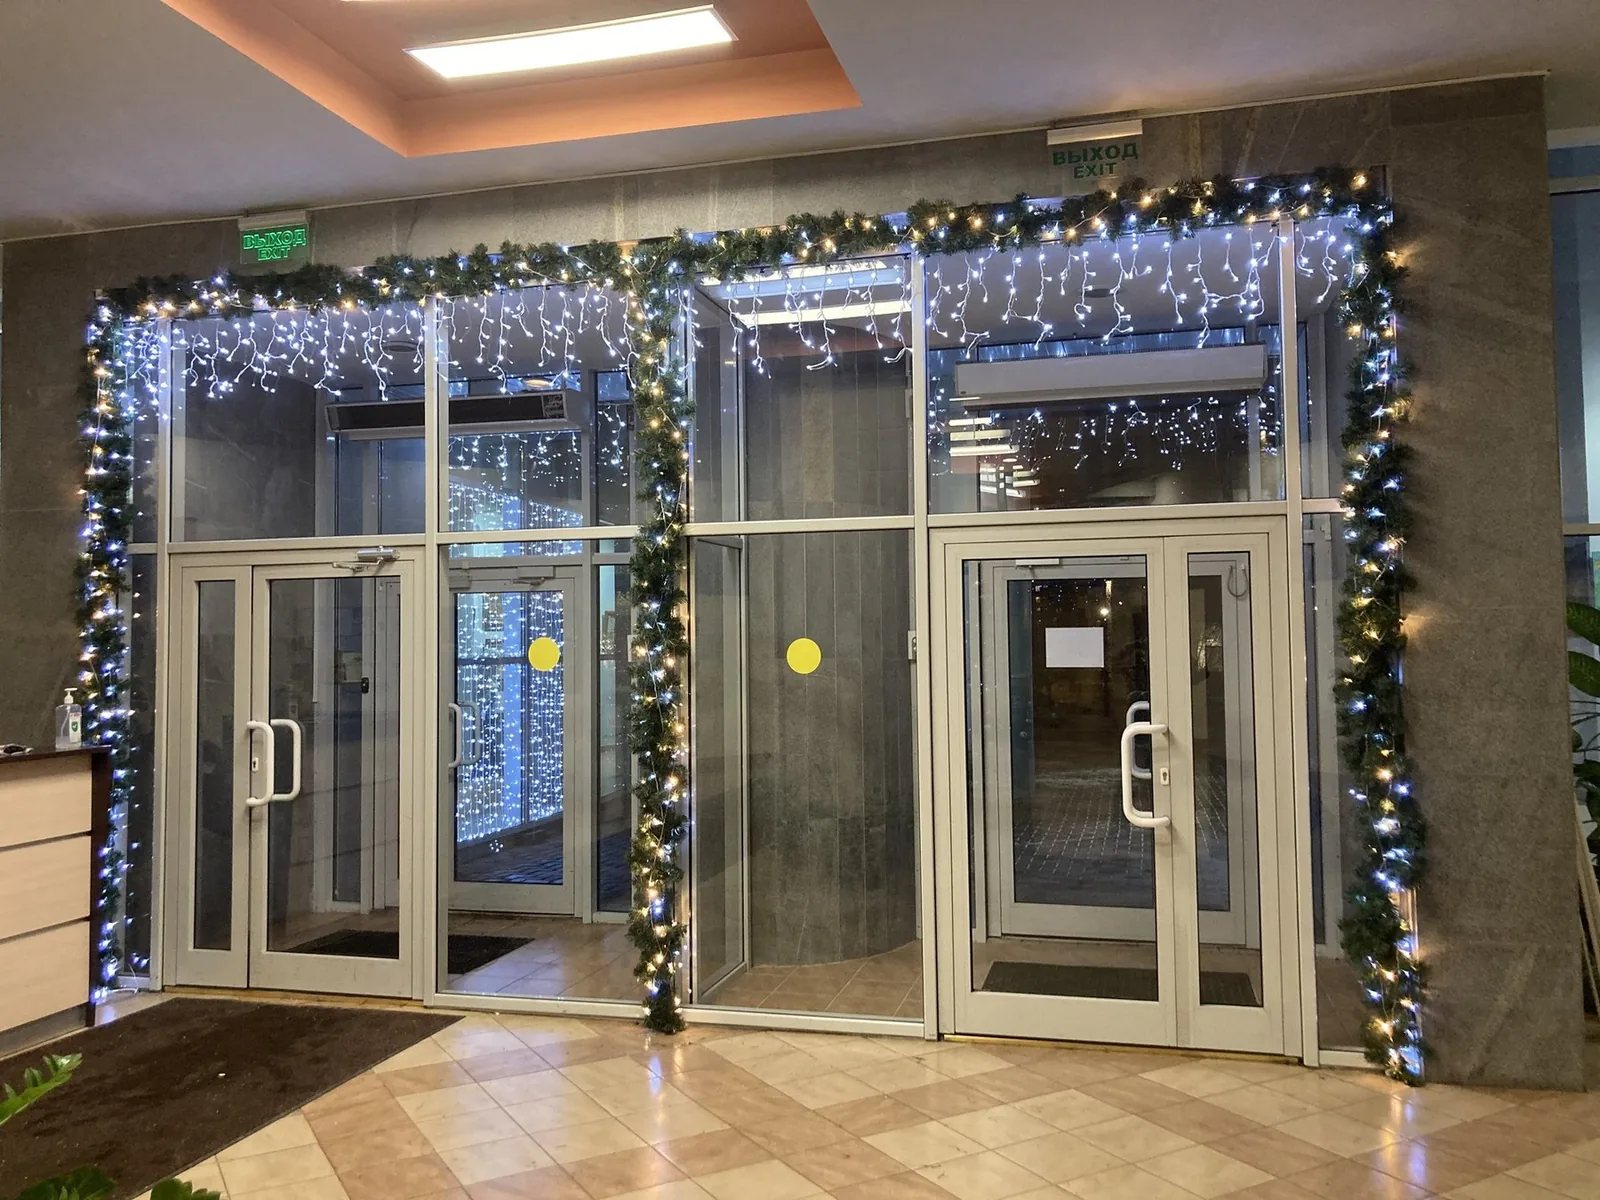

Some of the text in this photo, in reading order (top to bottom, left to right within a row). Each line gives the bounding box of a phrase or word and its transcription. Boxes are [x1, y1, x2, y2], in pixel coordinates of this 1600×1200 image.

[1052, 142, 1138, 166] ВЫХОД
[1073, 162, 1117, 179] EXIT
[243, 229, 306, 250] ВЫХОД
[257, 245, 291, 261] EXIT
